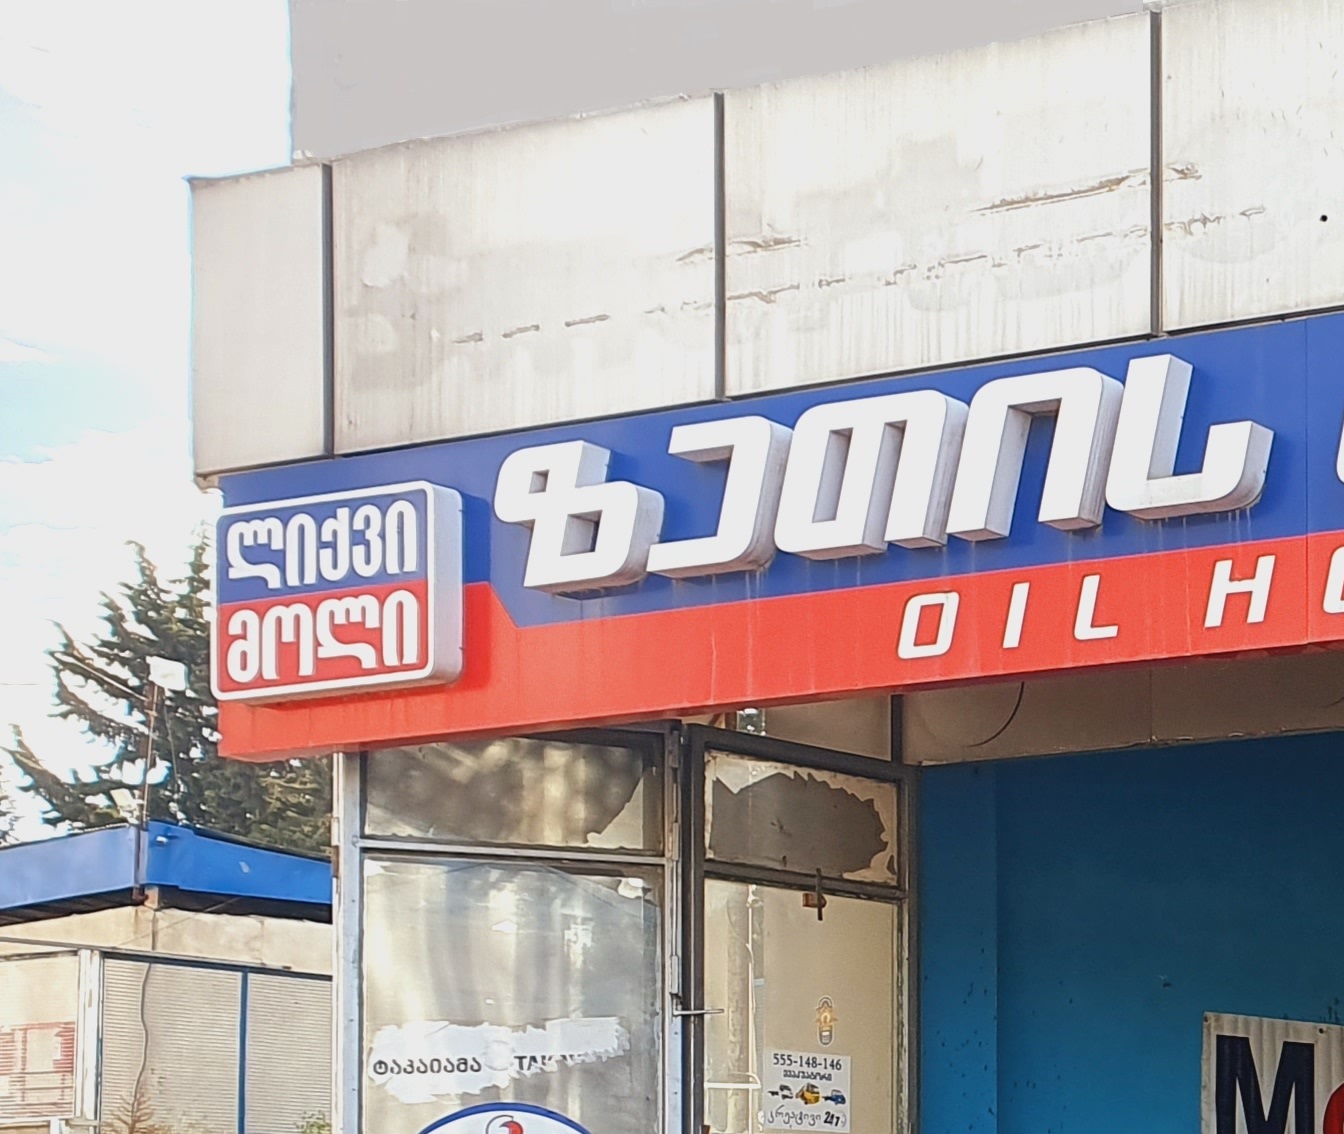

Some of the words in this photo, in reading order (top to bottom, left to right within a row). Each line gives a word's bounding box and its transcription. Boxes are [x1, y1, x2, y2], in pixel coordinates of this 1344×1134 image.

[493, 354, 1274, 594] ზეთის
[227, 498, 420, 591] ლიქვი
[226, 586, 421, 685] მოლი
[896, 575, 1119, 660] OIL
[373, 1056, 482, 1075] ტაკაიამა
[773, 1053, 842, 1072] 555-148-146
